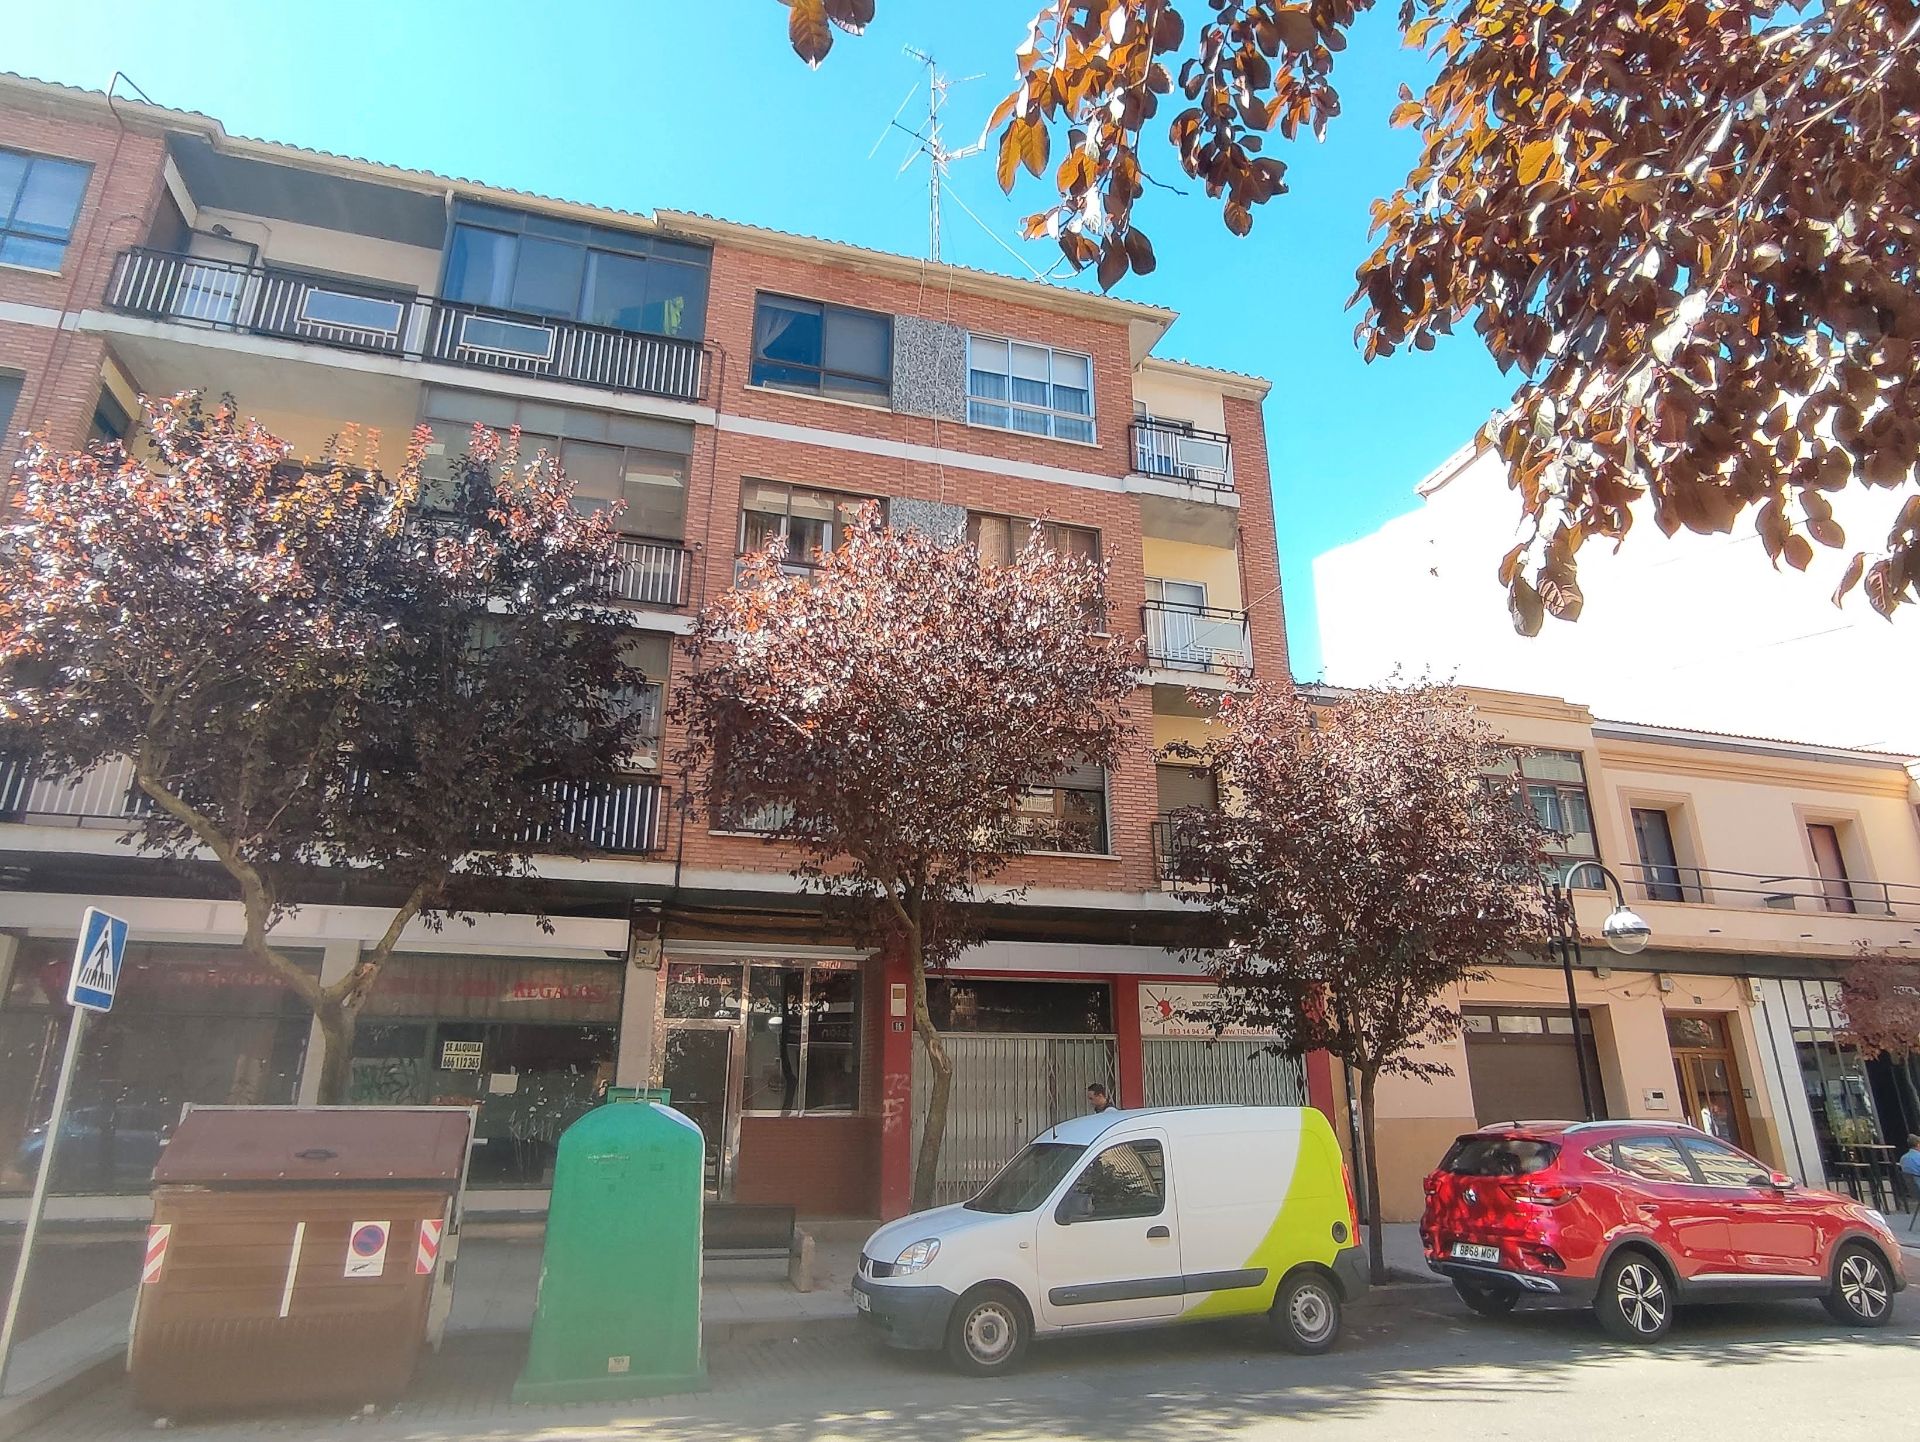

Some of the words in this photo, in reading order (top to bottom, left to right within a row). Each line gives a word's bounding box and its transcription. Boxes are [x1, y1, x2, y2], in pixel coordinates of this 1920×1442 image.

[679, 974, 696, 984] Las
[697, 972, 732, 985] Farolas
[698, 996, 711, 1008] 16
[445, 1042, 454, 1052] SE
[455, 1042, 481, 1053] ALQUILA
[1481, 1248, 1496, 1259] MGK
